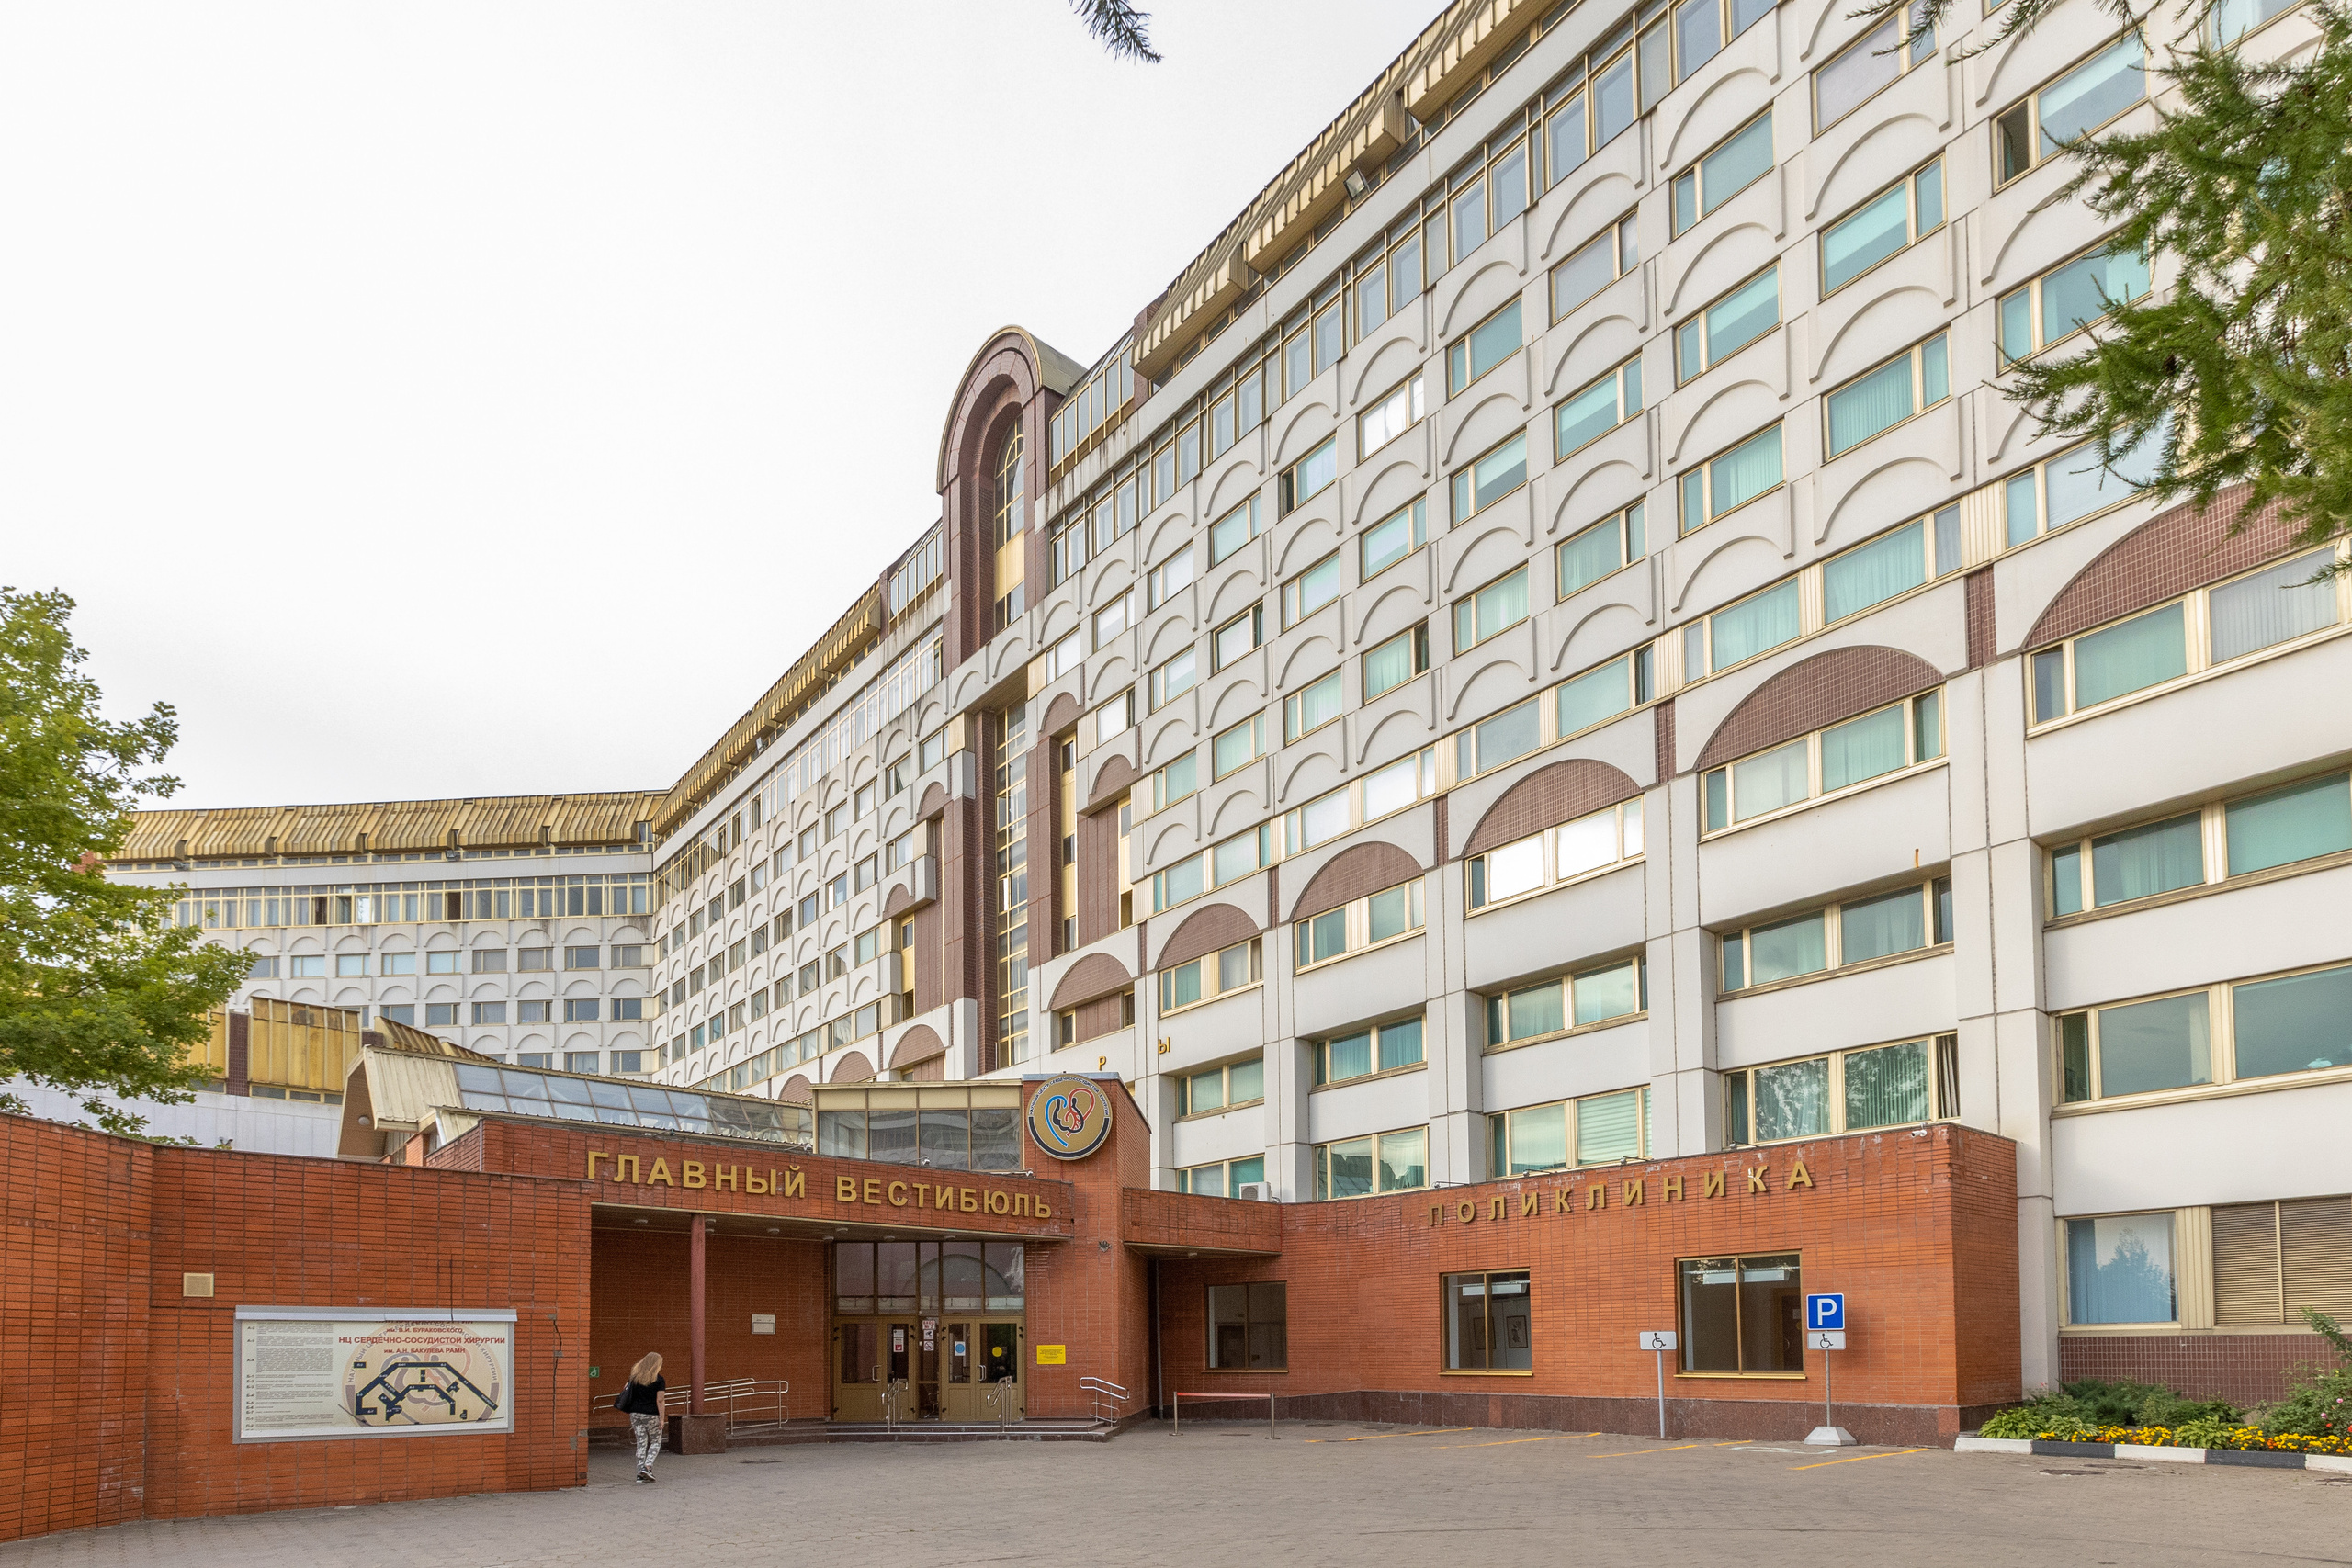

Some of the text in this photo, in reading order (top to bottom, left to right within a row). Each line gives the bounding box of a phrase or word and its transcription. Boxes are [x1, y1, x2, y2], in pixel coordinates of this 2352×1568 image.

[587, 1150, 1052, 1218] ГЛАВНЫЙ ВЕСТИБЮЛЬ
[1429, 1160, 1814, 1226] ПОЛИКЛИНИКА
[1817, 1298, 1838, 1326] P
[481, 1348, 497, 1381] ХИРУРГИИ
